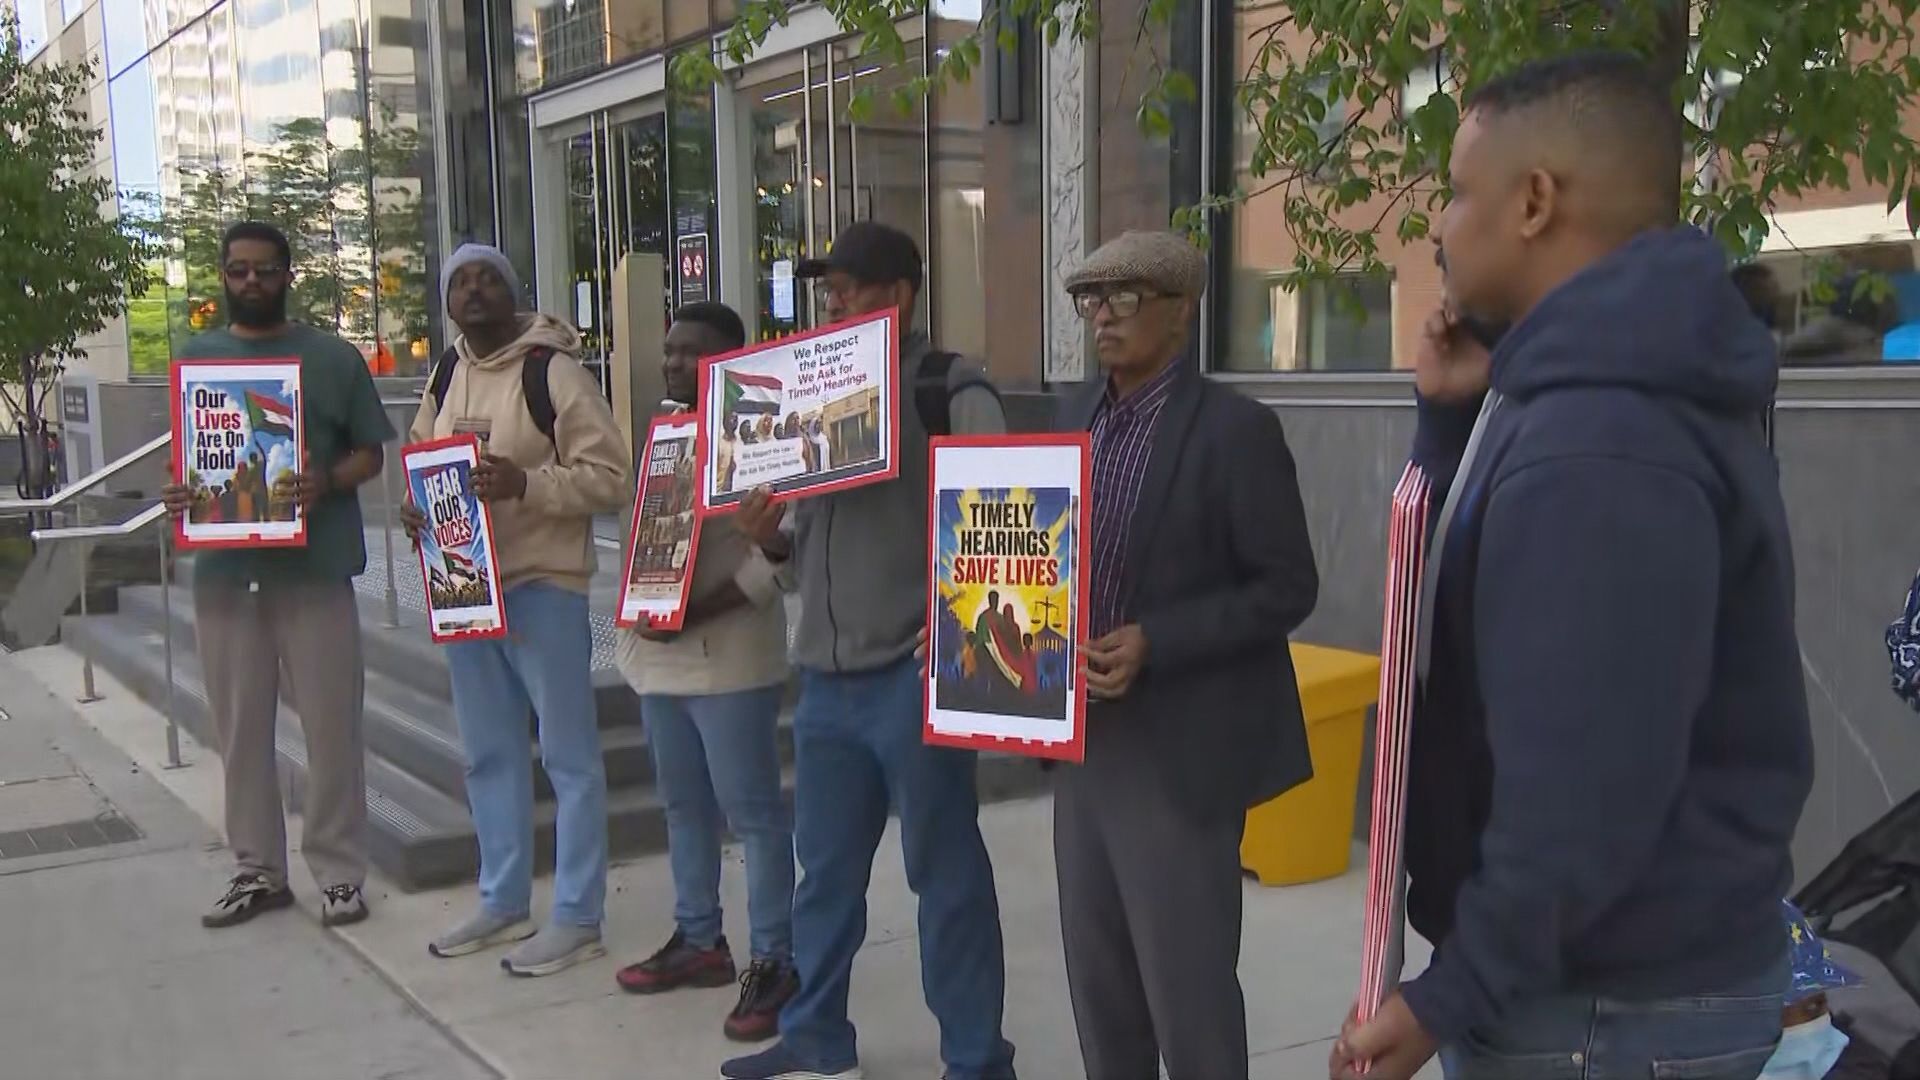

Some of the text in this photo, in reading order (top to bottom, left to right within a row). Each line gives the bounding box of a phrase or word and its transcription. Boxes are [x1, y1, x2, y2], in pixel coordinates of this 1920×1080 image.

[794, 335, 859, 360] We Respect
[797, 364, 854, 385] We Ask for
[799, 360, 817, 372] the
[819, 353, 842, 366] Law
[195, 389, 228, 408] Our
[788, 373, 867, 399] Timely Hearings
[195, 409, 241, 430] Lives
[196, 431, 245, 448] Are On
[196, 449, 235, 470] Hold
[423, 467, 464, 503] HEAR
[434, 495, 463, 525] OUR
[969, 503, 1035, 528] TIMELY
[433, 517, 473, 548] VOICES
[960, 530, 1050, 557] HEARINGS
[954, 557, 1058, 586] SAVE LIVES
